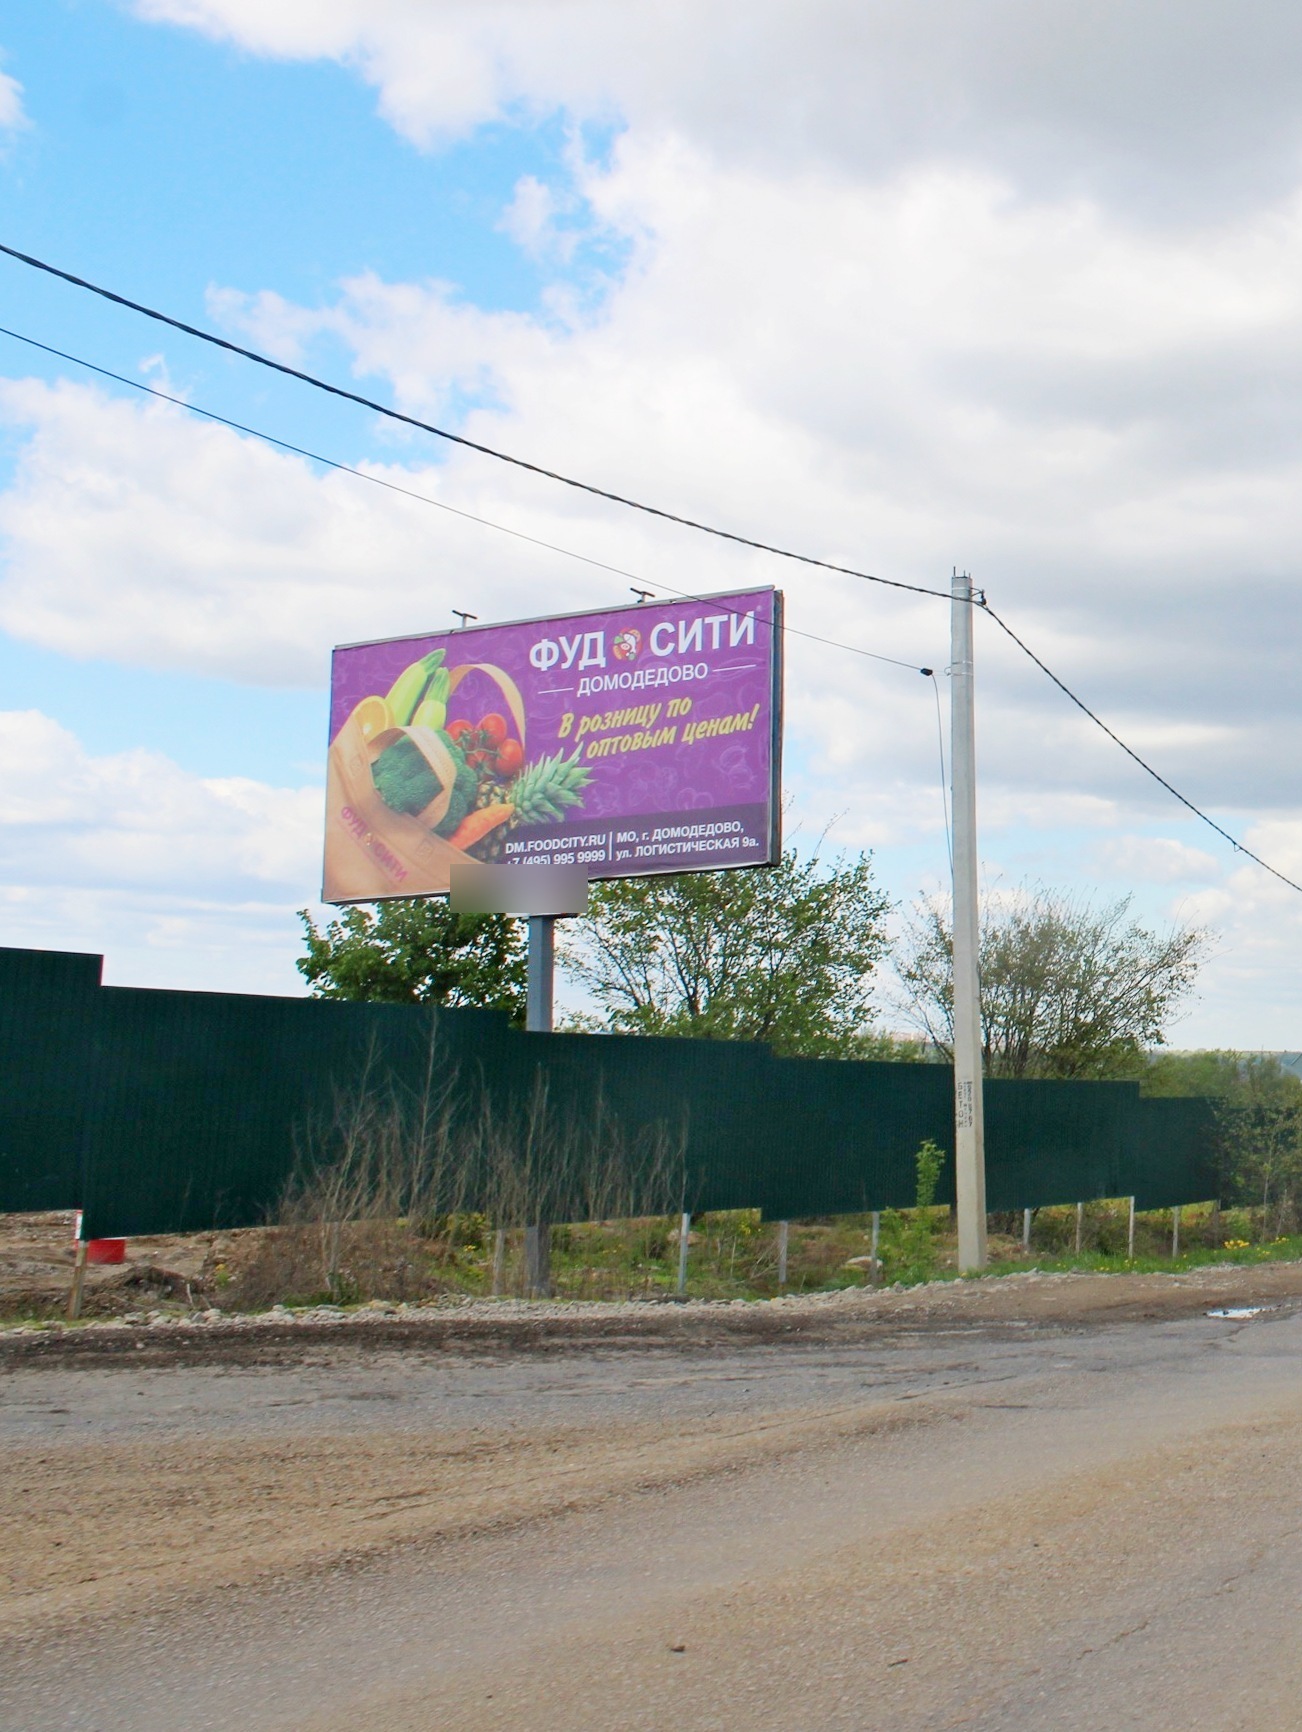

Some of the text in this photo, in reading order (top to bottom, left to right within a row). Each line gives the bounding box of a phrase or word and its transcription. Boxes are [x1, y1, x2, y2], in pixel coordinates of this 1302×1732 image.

[529, 611, 755, 671] ФУД СИТИ
[576, 662, 708, 697] ДОМОДЕДОВО
[558, 697, 692, 742] В розницу по
[586, 703, 760, 759] оптовым ценам!
[505, 833, 606, 854] DM.FOODCITY.RU
[616, 820, 744, 843] МО, г. ДОМОДЕДОВО,
[553, 852, 575, 864] 995
[577, 850, 606, 863] 9999
[616, 836, 760, 861] ул. ЛОГИСТИЧЕСКАЯ 9а.
